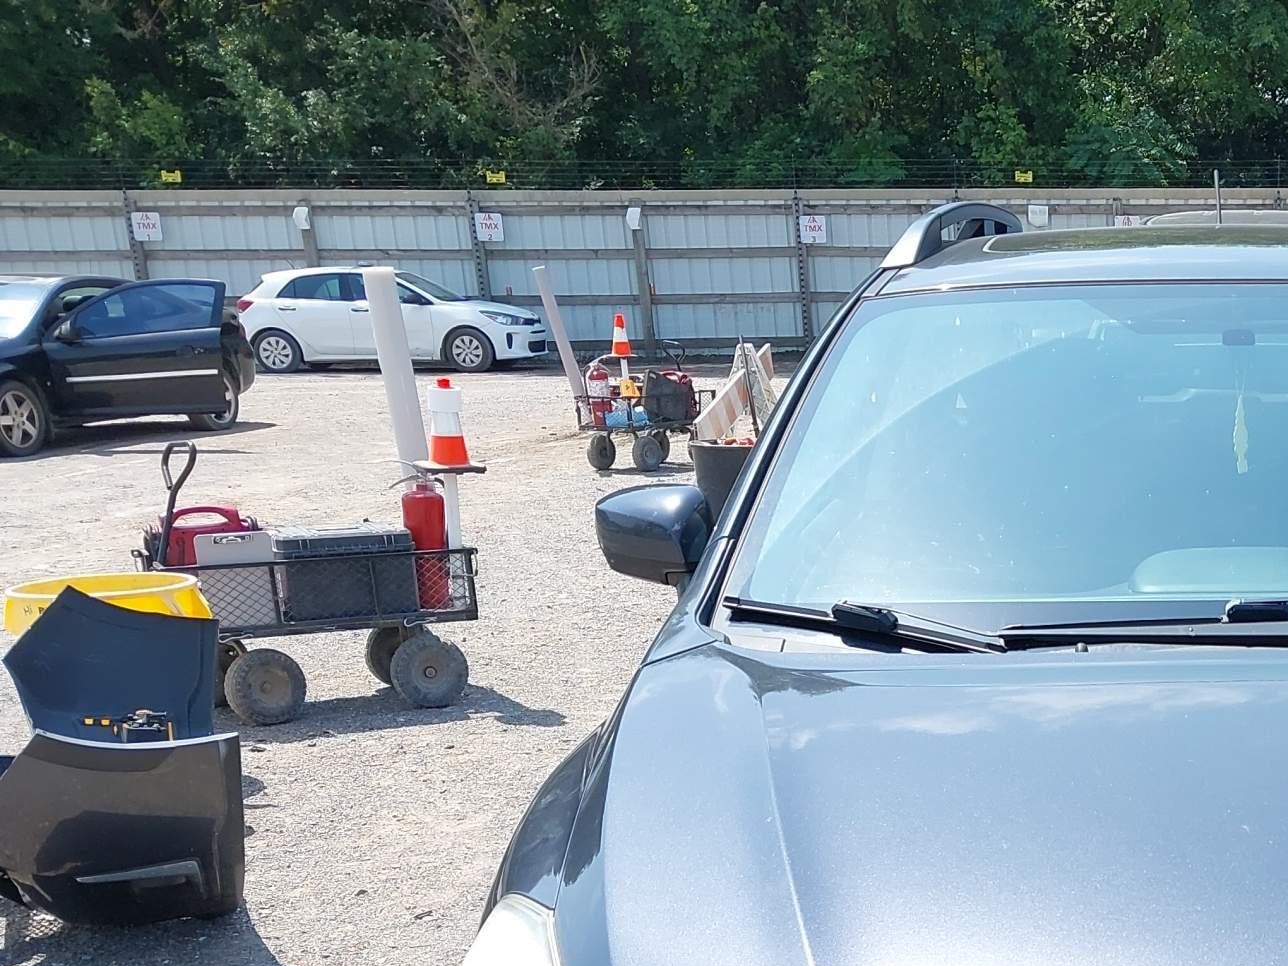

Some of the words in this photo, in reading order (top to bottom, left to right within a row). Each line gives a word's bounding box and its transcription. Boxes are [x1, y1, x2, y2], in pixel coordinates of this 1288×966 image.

[136, 222, 157, 230] TMX
[480, 222, 499, 230] TMX
[804, 224, 823, 232] TMX
[487, 233, 493, 241] 2
